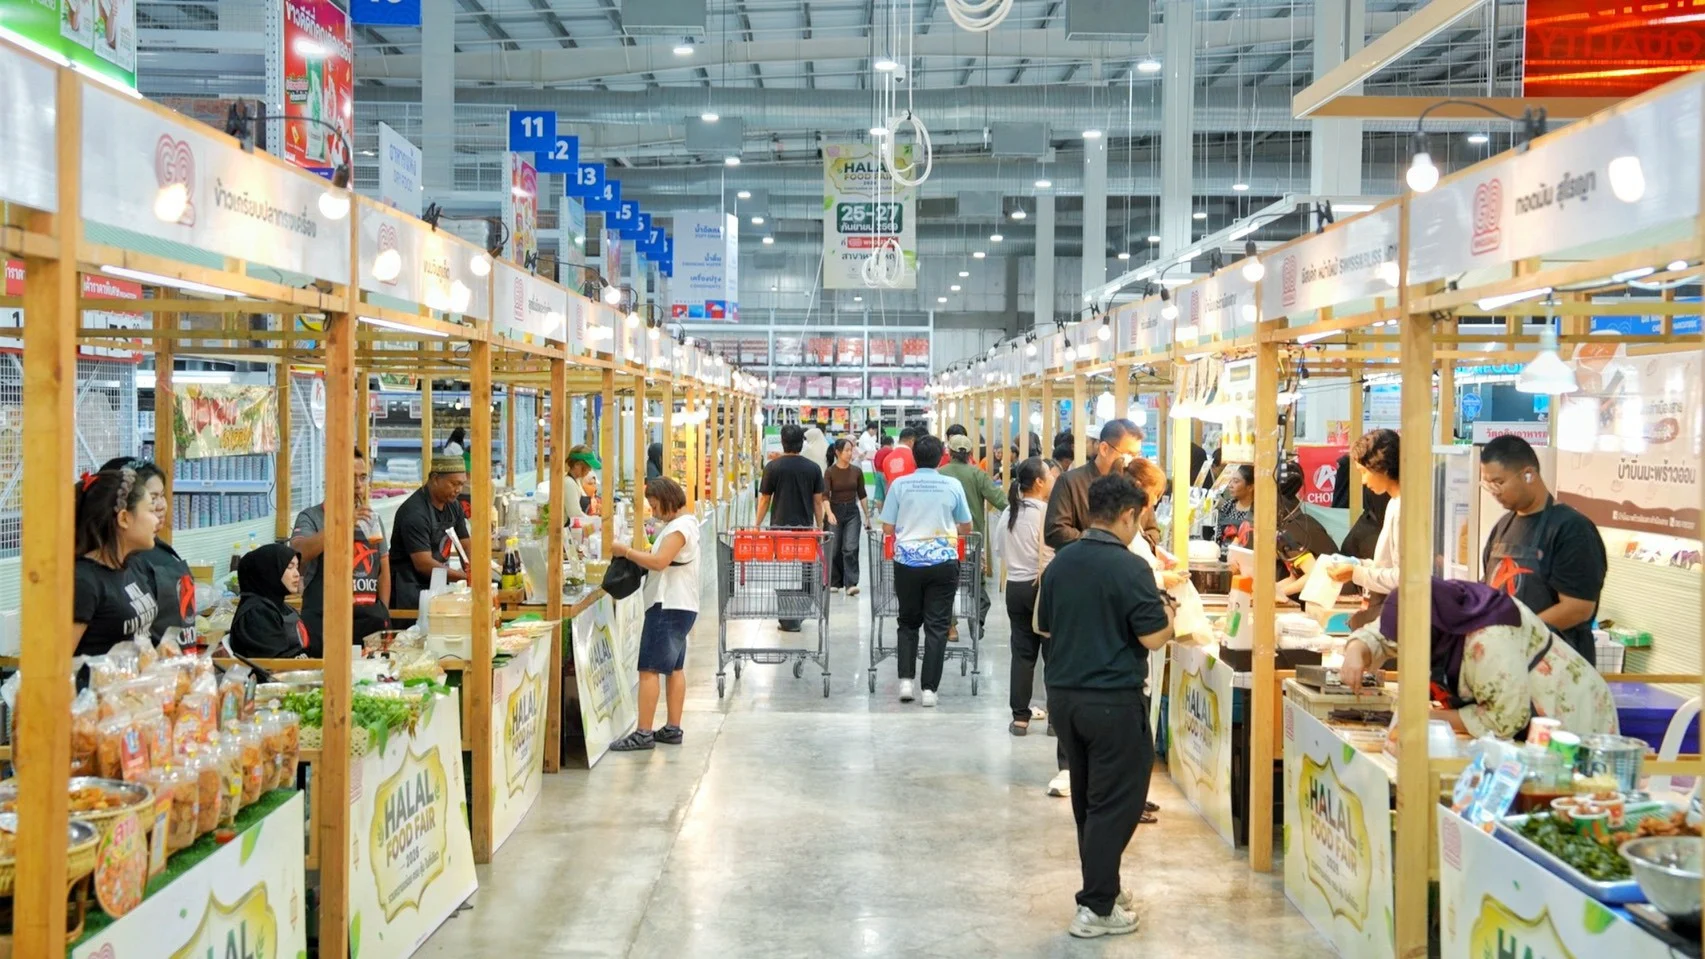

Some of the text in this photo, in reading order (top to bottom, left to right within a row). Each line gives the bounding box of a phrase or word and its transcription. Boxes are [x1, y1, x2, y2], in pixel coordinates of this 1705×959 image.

[521, 116, 544, 138] 11
[548, 140, 569, 161] 2
[844, 162, 890, 173] HALA
[844, 173, 872, 181] FOOD
[595, 184, 613, 201] 4
[1515, 182, 1553, 216] ทอดมัน
[841, 205, 899, 222] 25-27
[1617, 454, 1697, 485] บ้าบิ่นมะพร้าวอ่อน
[589, 637, 612, 674] HALAL
[512, 688, 536, 735] HALAL
[1186, 684, 1213, 731] HALAL
[1185, 712, 1198, 737] FOOD
[384, 767, 434, 839] HALAL
[1309, 775, 1357, 849] HALAL
[386, 806, 436, 868] FOOD FAIR
[1311, 812, 1358, 877] FOOD FAIR
